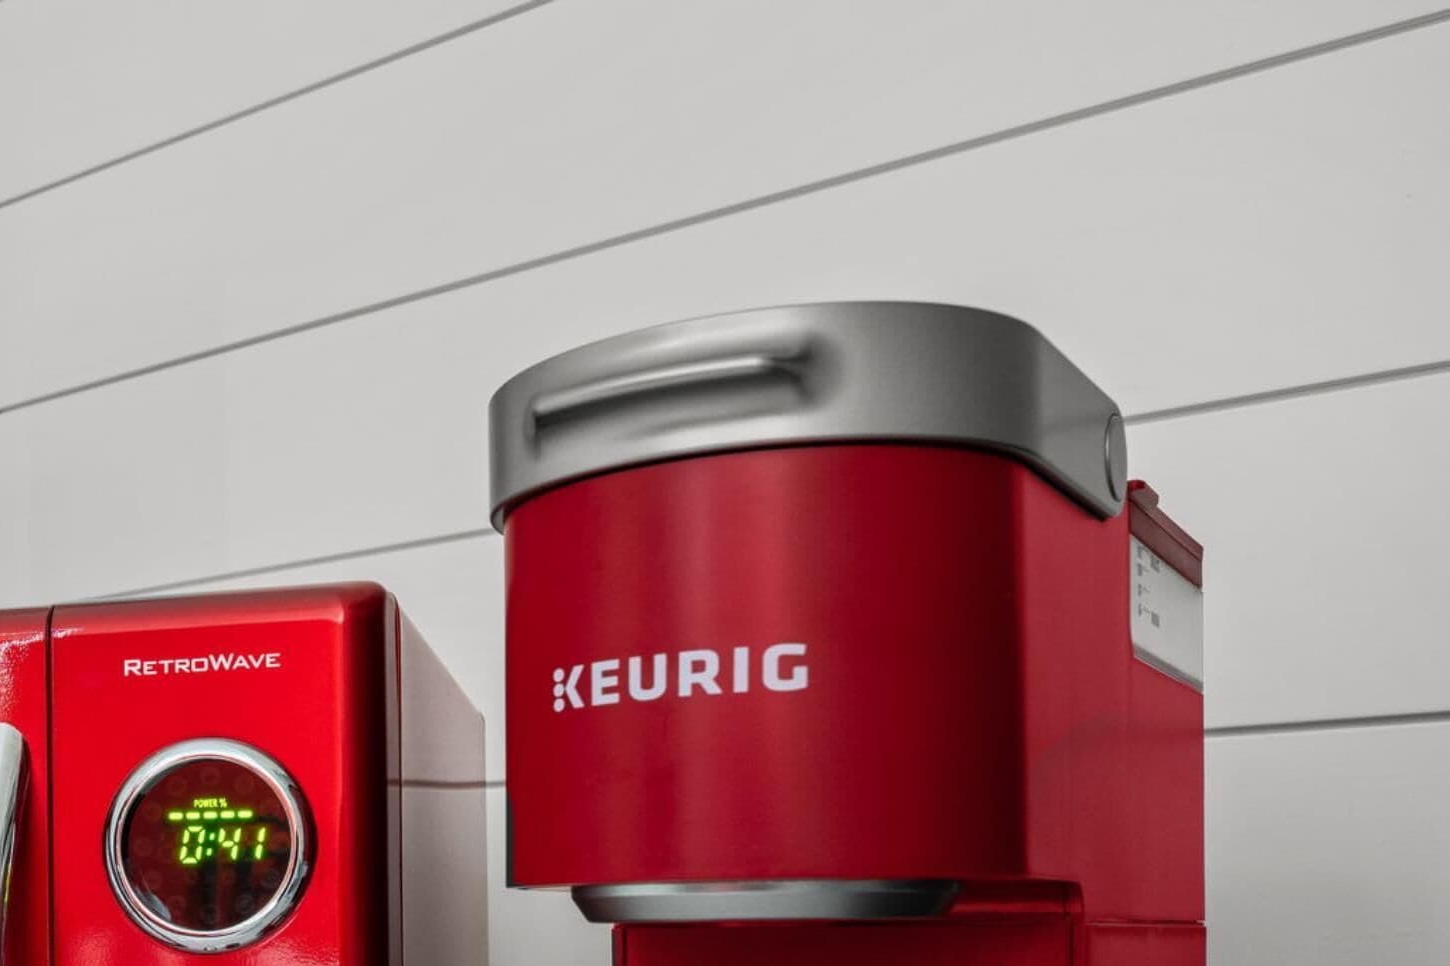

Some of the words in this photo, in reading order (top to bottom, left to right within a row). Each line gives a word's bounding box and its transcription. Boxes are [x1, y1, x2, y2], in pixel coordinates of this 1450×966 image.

[553, 643, 809, 712] KEURIG
[194, 798, 218, 808] POWER
[179, 826, 266, 865] 0:41
